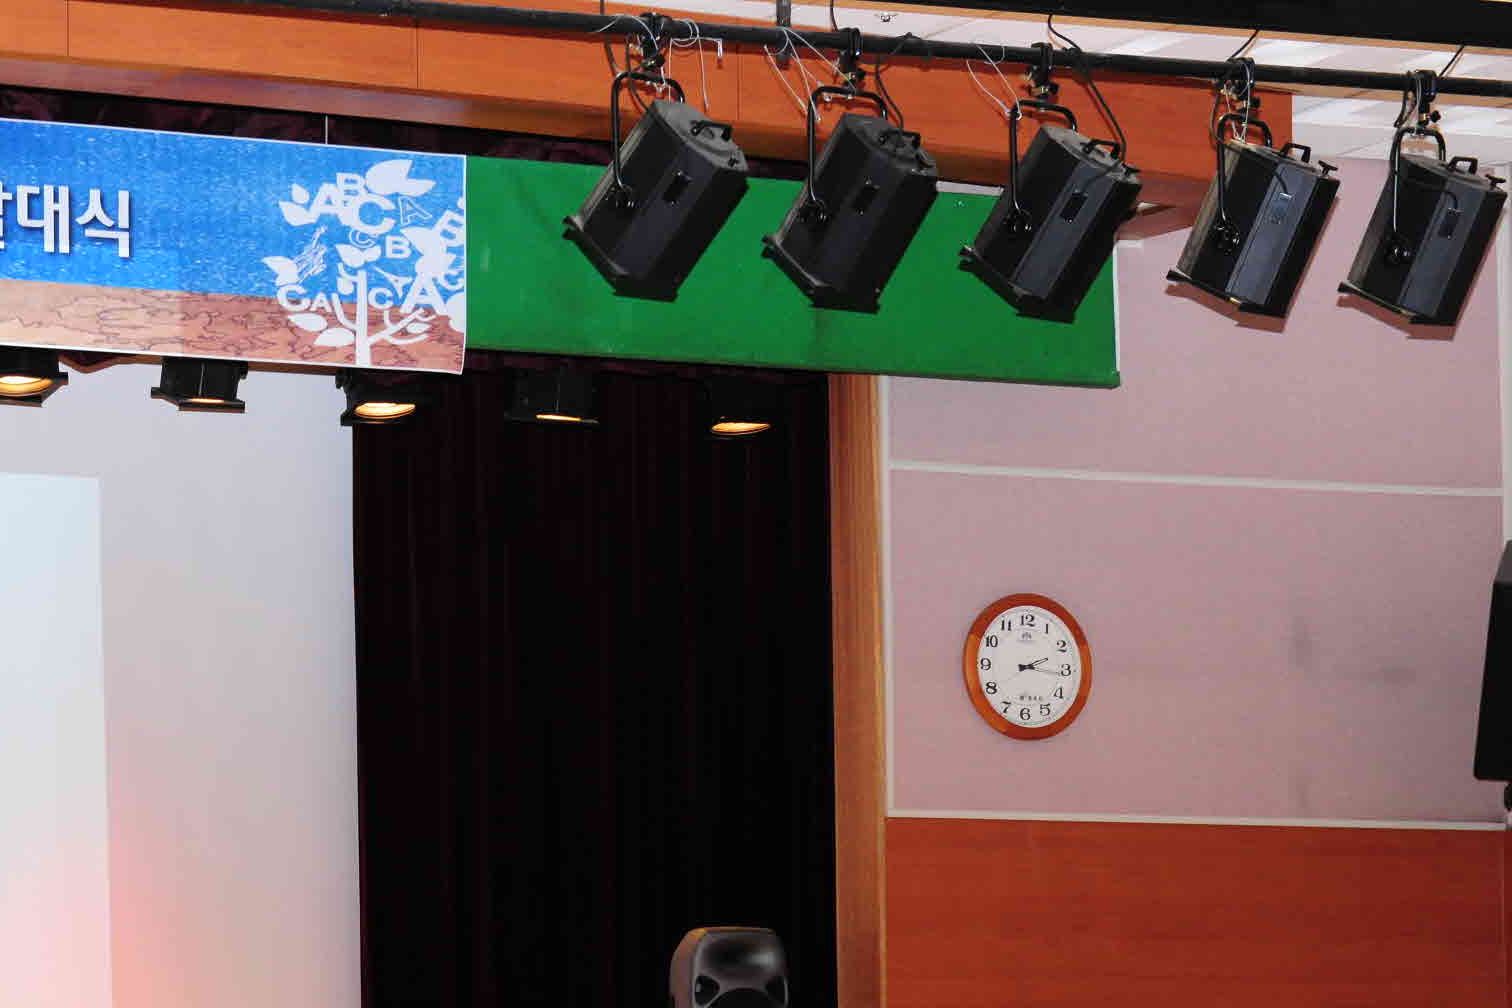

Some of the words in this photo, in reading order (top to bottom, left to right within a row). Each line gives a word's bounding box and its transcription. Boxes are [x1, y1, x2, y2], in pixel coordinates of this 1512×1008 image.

[1001, 619, 1012, 631] 11
[1019, 614, 1036, 627] 12
[985, 635, 999, 648] 10
[1056, 640, 1067, 652] 2
[980, 657, 992, 671] 9
[1060, 663, 1071, 676] 3
[985, 681, 998, 695] 8
[1053, 687, 1064, 699] 4
[1002, 701, 1012, 714] 7
[1019, 707, 1031, 720] 6
[1039, 703, 1051, 716] 5
